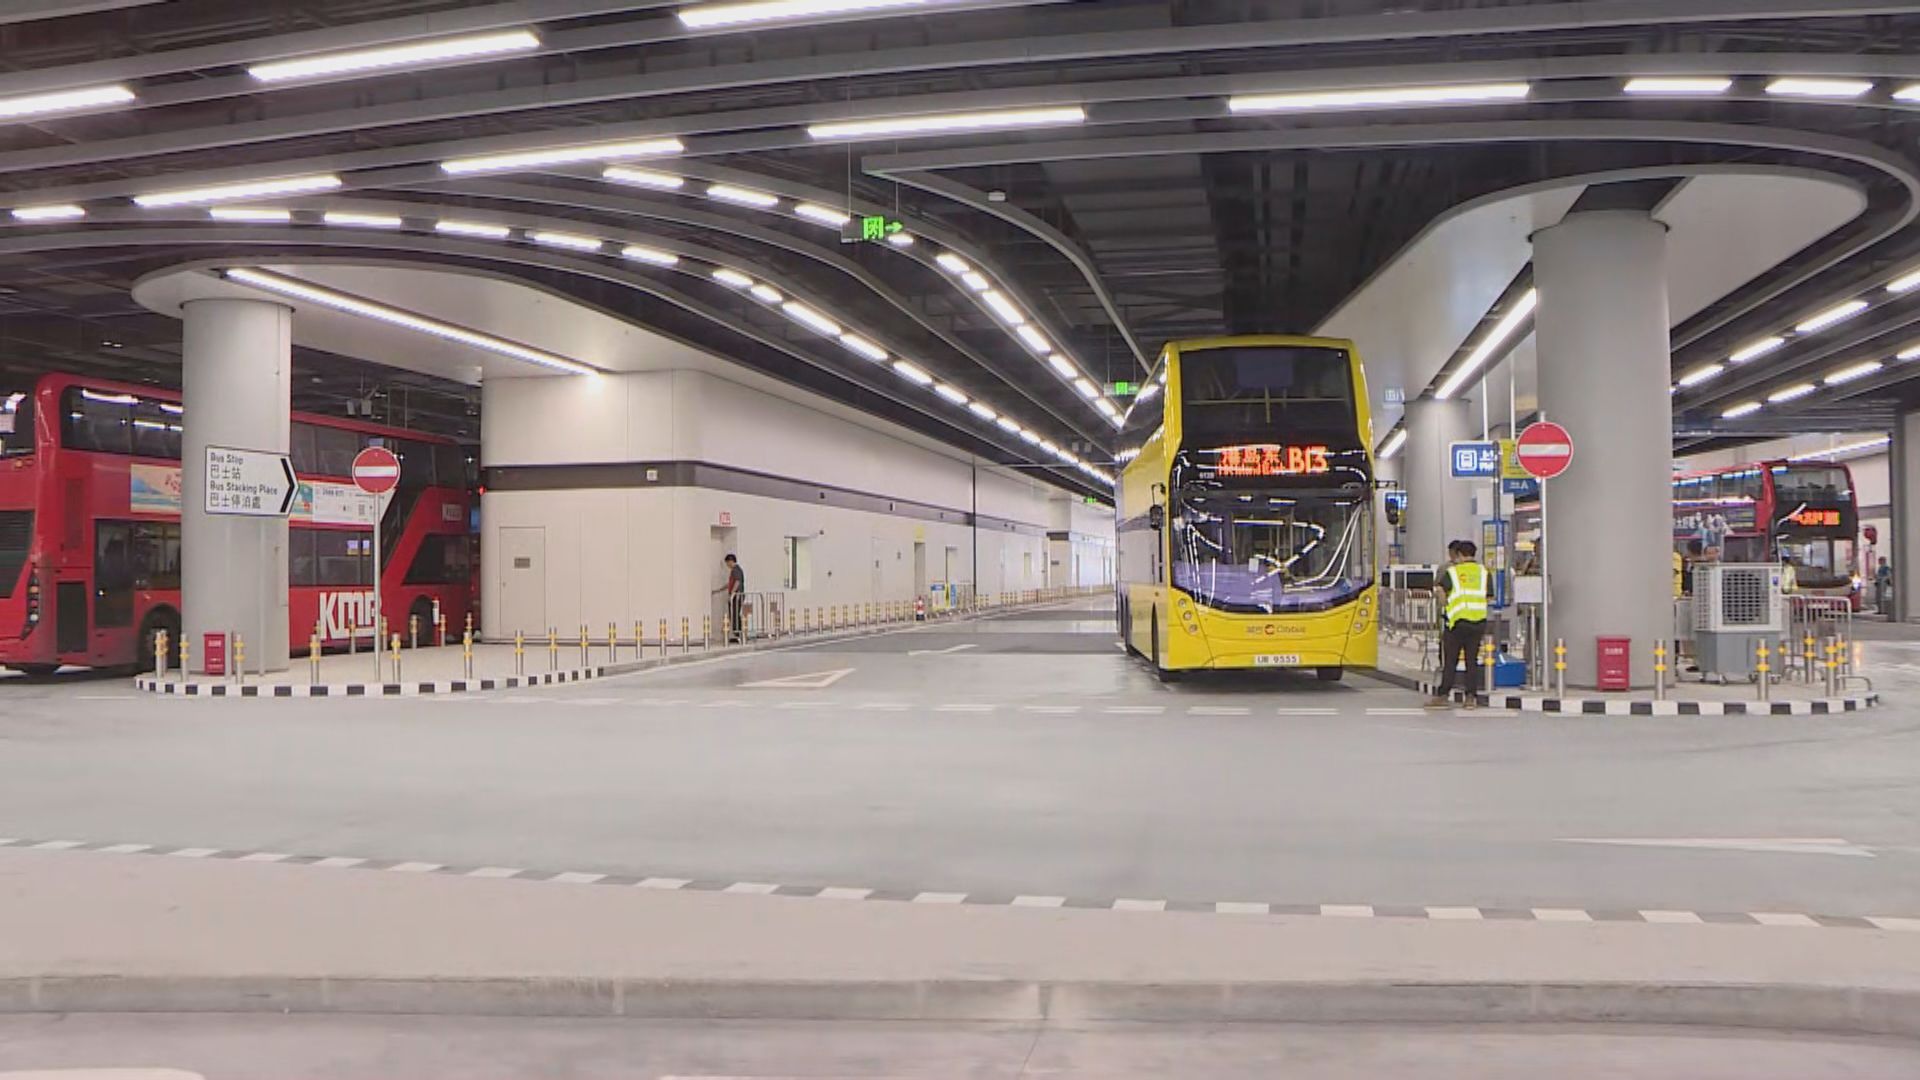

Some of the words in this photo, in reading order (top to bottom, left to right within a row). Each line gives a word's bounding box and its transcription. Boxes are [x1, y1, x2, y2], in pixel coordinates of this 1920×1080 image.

[210, 452, 224, 461] Bus
[226, 454, 244, 465] Stop
[1288, 446, 1328, 474] B13
[210, 464, 241, 481] 巴士站
[210, 480, 224, 491] Bus
[226, 482, 258, 495] Stacking
[259, 484, 278, 495] Place
